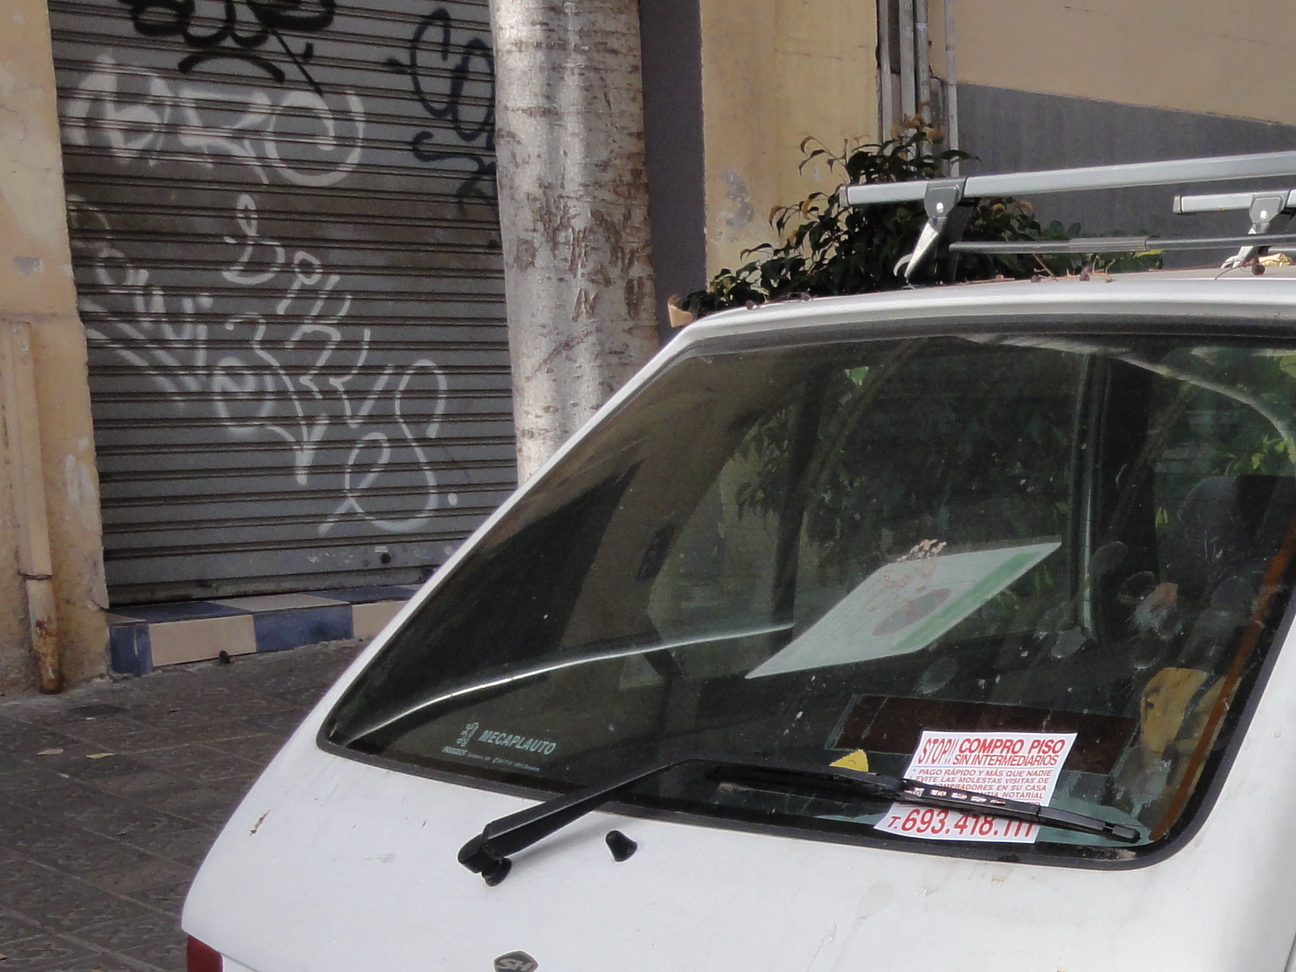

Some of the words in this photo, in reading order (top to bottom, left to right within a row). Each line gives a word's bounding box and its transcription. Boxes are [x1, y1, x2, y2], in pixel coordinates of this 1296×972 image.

[478, 730, 556, 755] MECAPLAUTO
[959, 738, 1023, 754] COMPRO
[1028, 739, 1066, 754] PISO
[952, 754, 971, 766] SIN
[969, 754, 1059, 767] INTERMEDIARIOS
[944, 768, 976, 776] RÁPIDO
[985, 768, 1004, 777] MÁS
[1025, 769, 1053, 777] NADIE
[958, 776, 1003, 784] MOLESTAS
[1024, 784, 1047, 792] CASA
[1001, 791, 1044, 799] NOTARIAL
